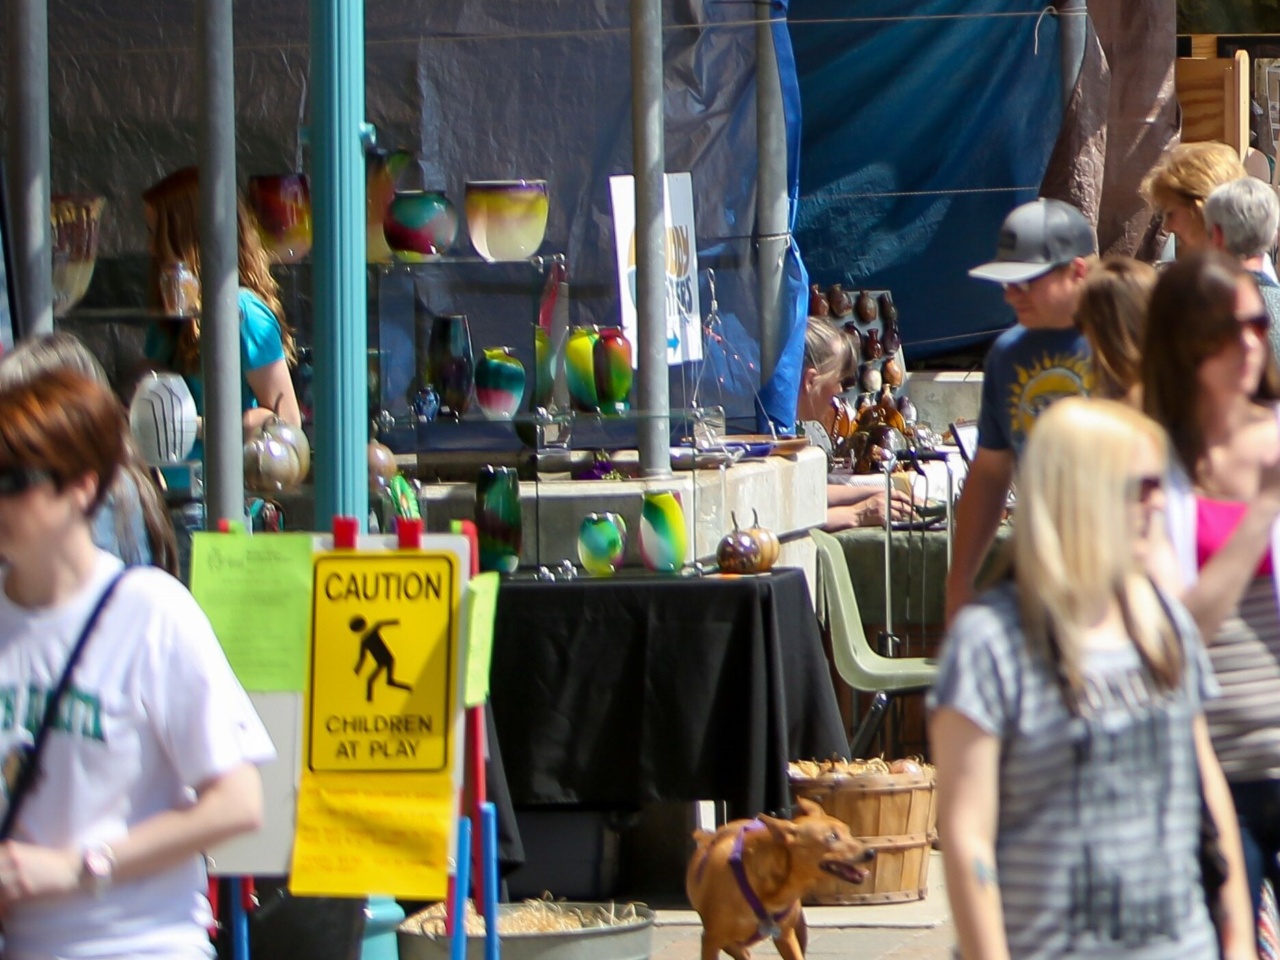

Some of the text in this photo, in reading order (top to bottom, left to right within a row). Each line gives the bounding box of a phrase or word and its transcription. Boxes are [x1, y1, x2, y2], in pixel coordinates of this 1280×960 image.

[324, 571, 443, 601] CAUTION
[325, 713, 434, 735] CHILDREN
[335, 739, 421, 760] AT PLAY
